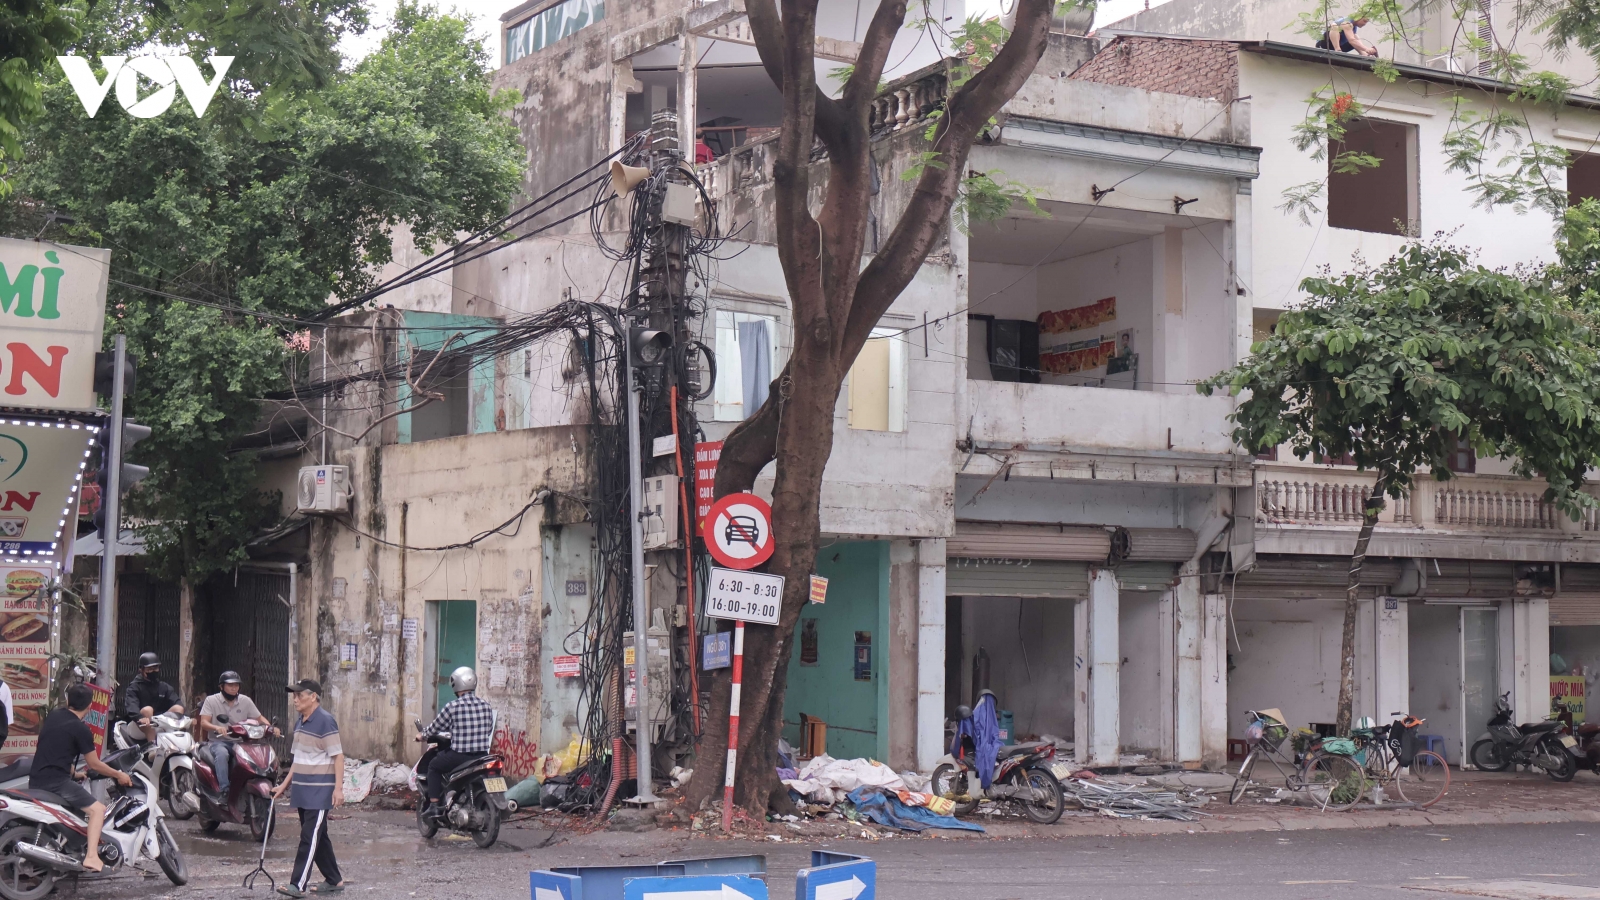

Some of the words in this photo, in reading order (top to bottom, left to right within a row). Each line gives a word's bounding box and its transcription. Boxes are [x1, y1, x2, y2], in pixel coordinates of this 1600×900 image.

[0, 342, 69, 399] N
[0, 491, 41, 512] N
[568, 583, 584, 593] 383
[719, 579, 743, 592] 6:30
[754, 584, 777, 597] 8:30
[1570, 679, 1584, 697] MÍA
